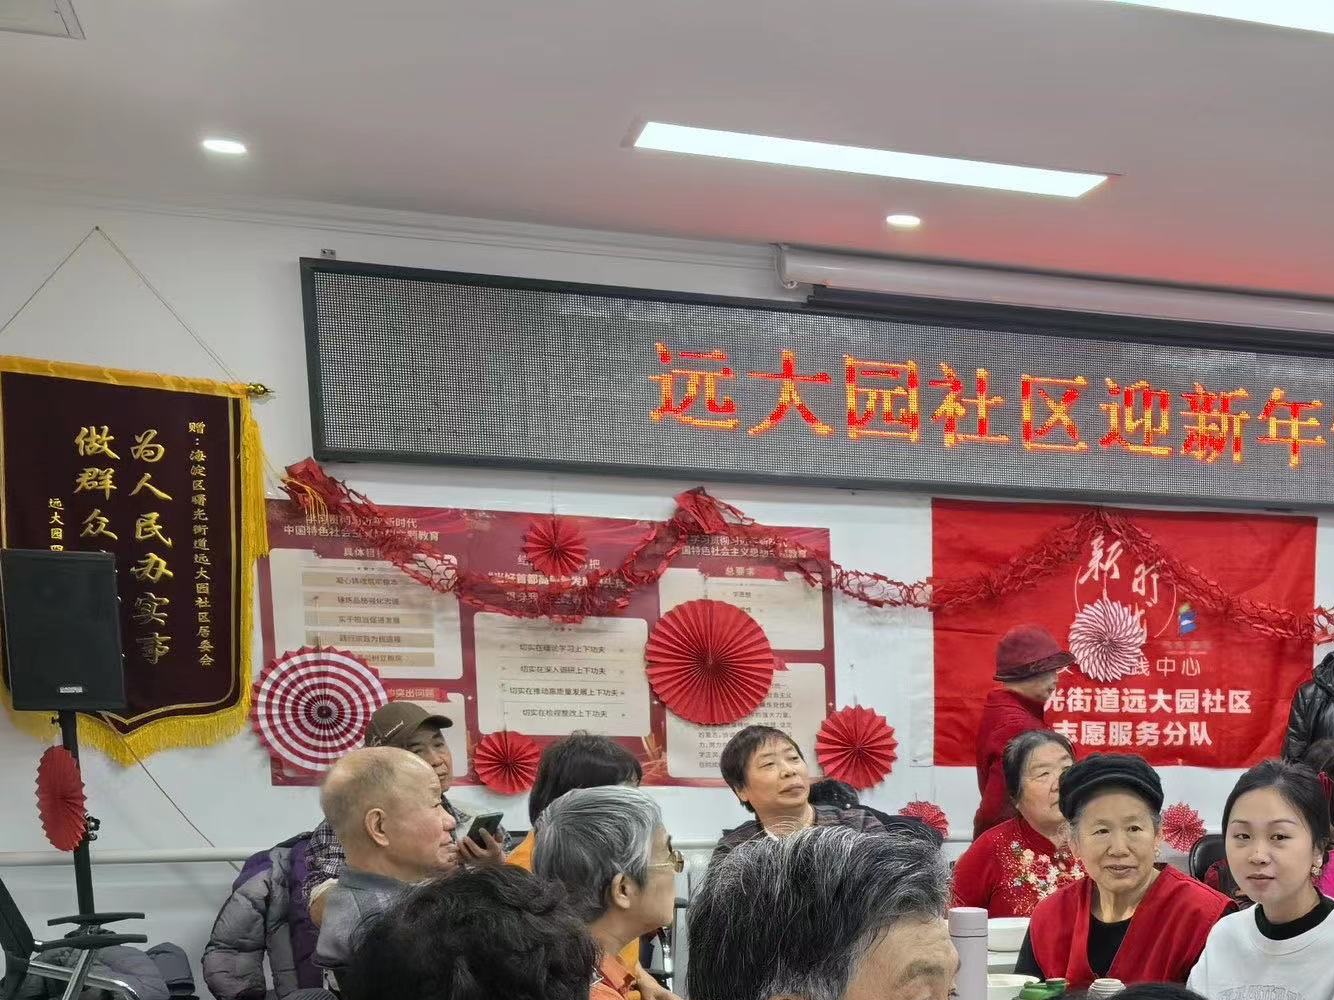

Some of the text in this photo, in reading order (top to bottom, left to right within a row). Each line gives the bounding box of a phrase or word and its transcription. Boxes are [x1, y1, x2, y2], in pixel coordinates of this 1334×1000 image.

[73, 424, 121, 552] 做群众
[129, 428, 175, 665] 为人民办实事
[1052, 719, 1213, 747] 志愿服务分队
